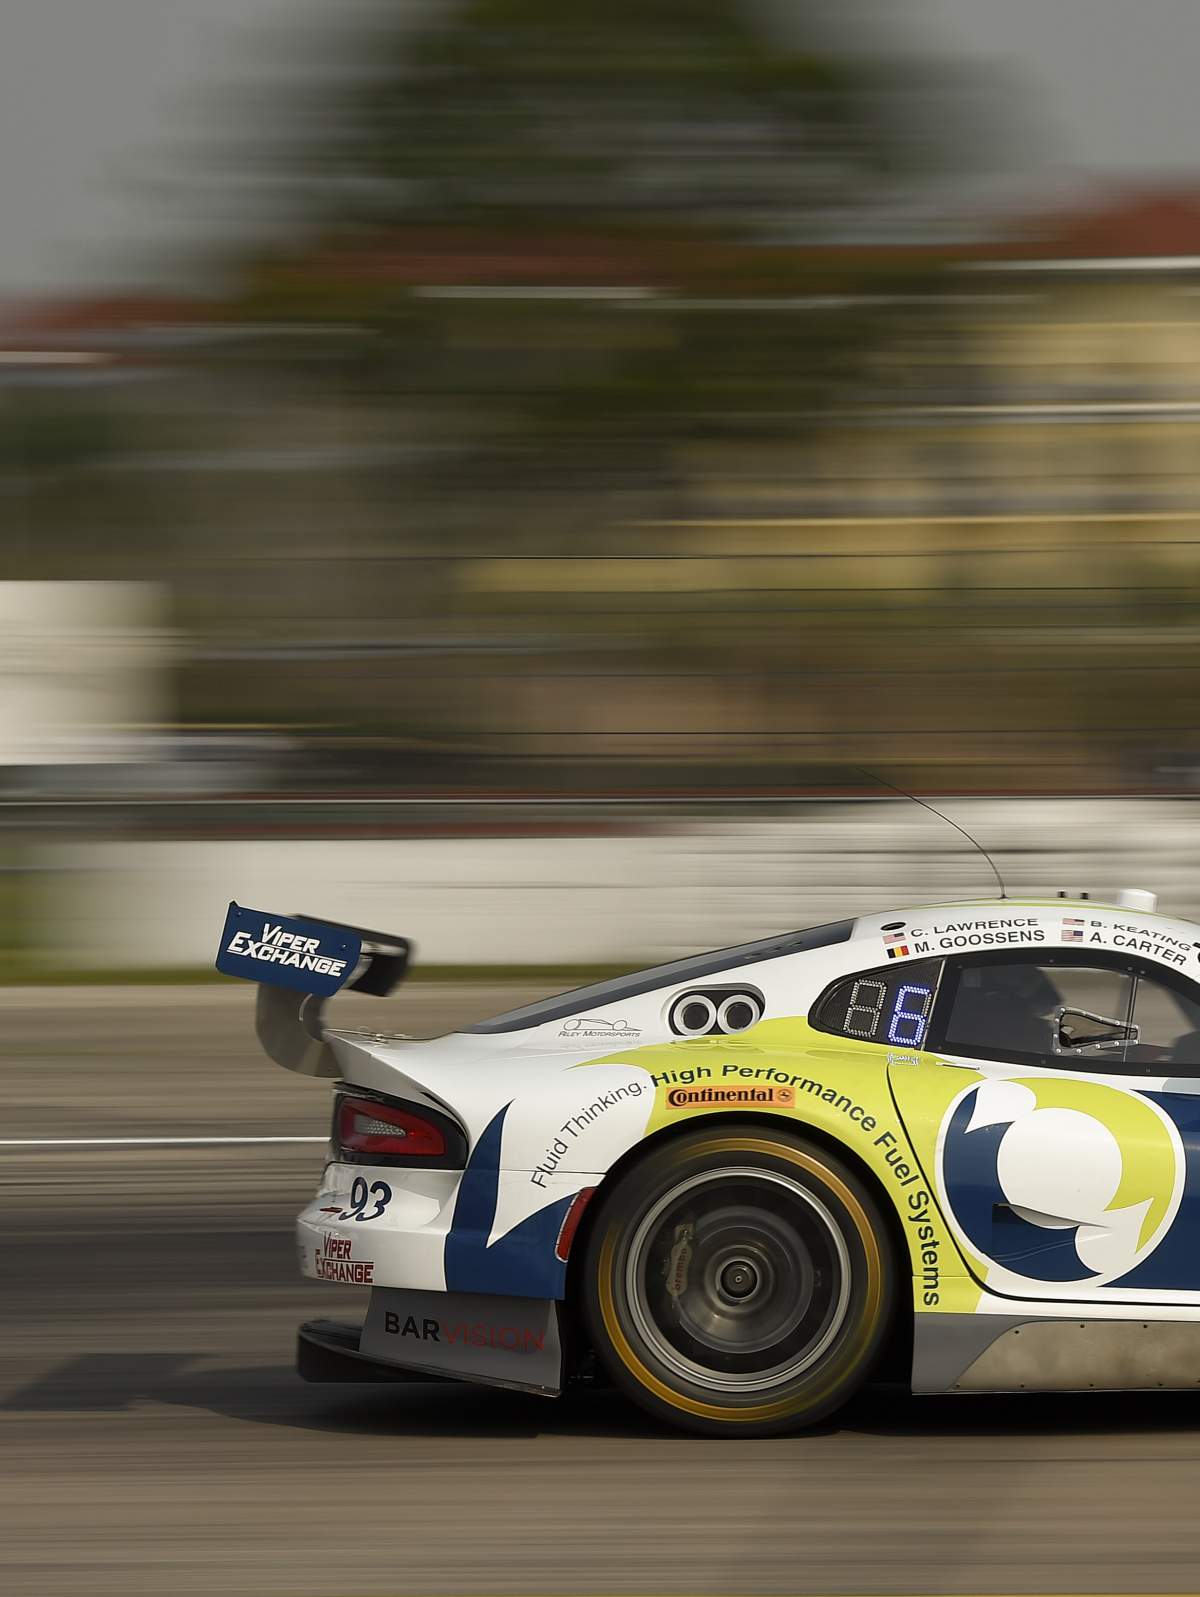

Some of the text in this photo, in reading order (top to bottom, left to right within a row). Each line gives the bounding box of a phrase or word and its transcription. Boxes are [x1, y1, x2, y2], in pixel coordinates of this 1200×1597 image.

[262, 923, 320, 954] VIPER
[911, 918, 1039, 938] C. LAWRENCE
[914, 930, 1045, 953] M. GOOSSENS
[1090, 920, 1191, 951] B. KEATING
[227, 931, 347, 977] EXCHANGE
[1089, 932, 1187, 966] A. CARTER
[668, 1088, 774, 1106] Continental
[338, 1176, 392, 1221] 93
[531, 1064, 939, 1306] Fluid Thinking. High Performance Fuel Systems
